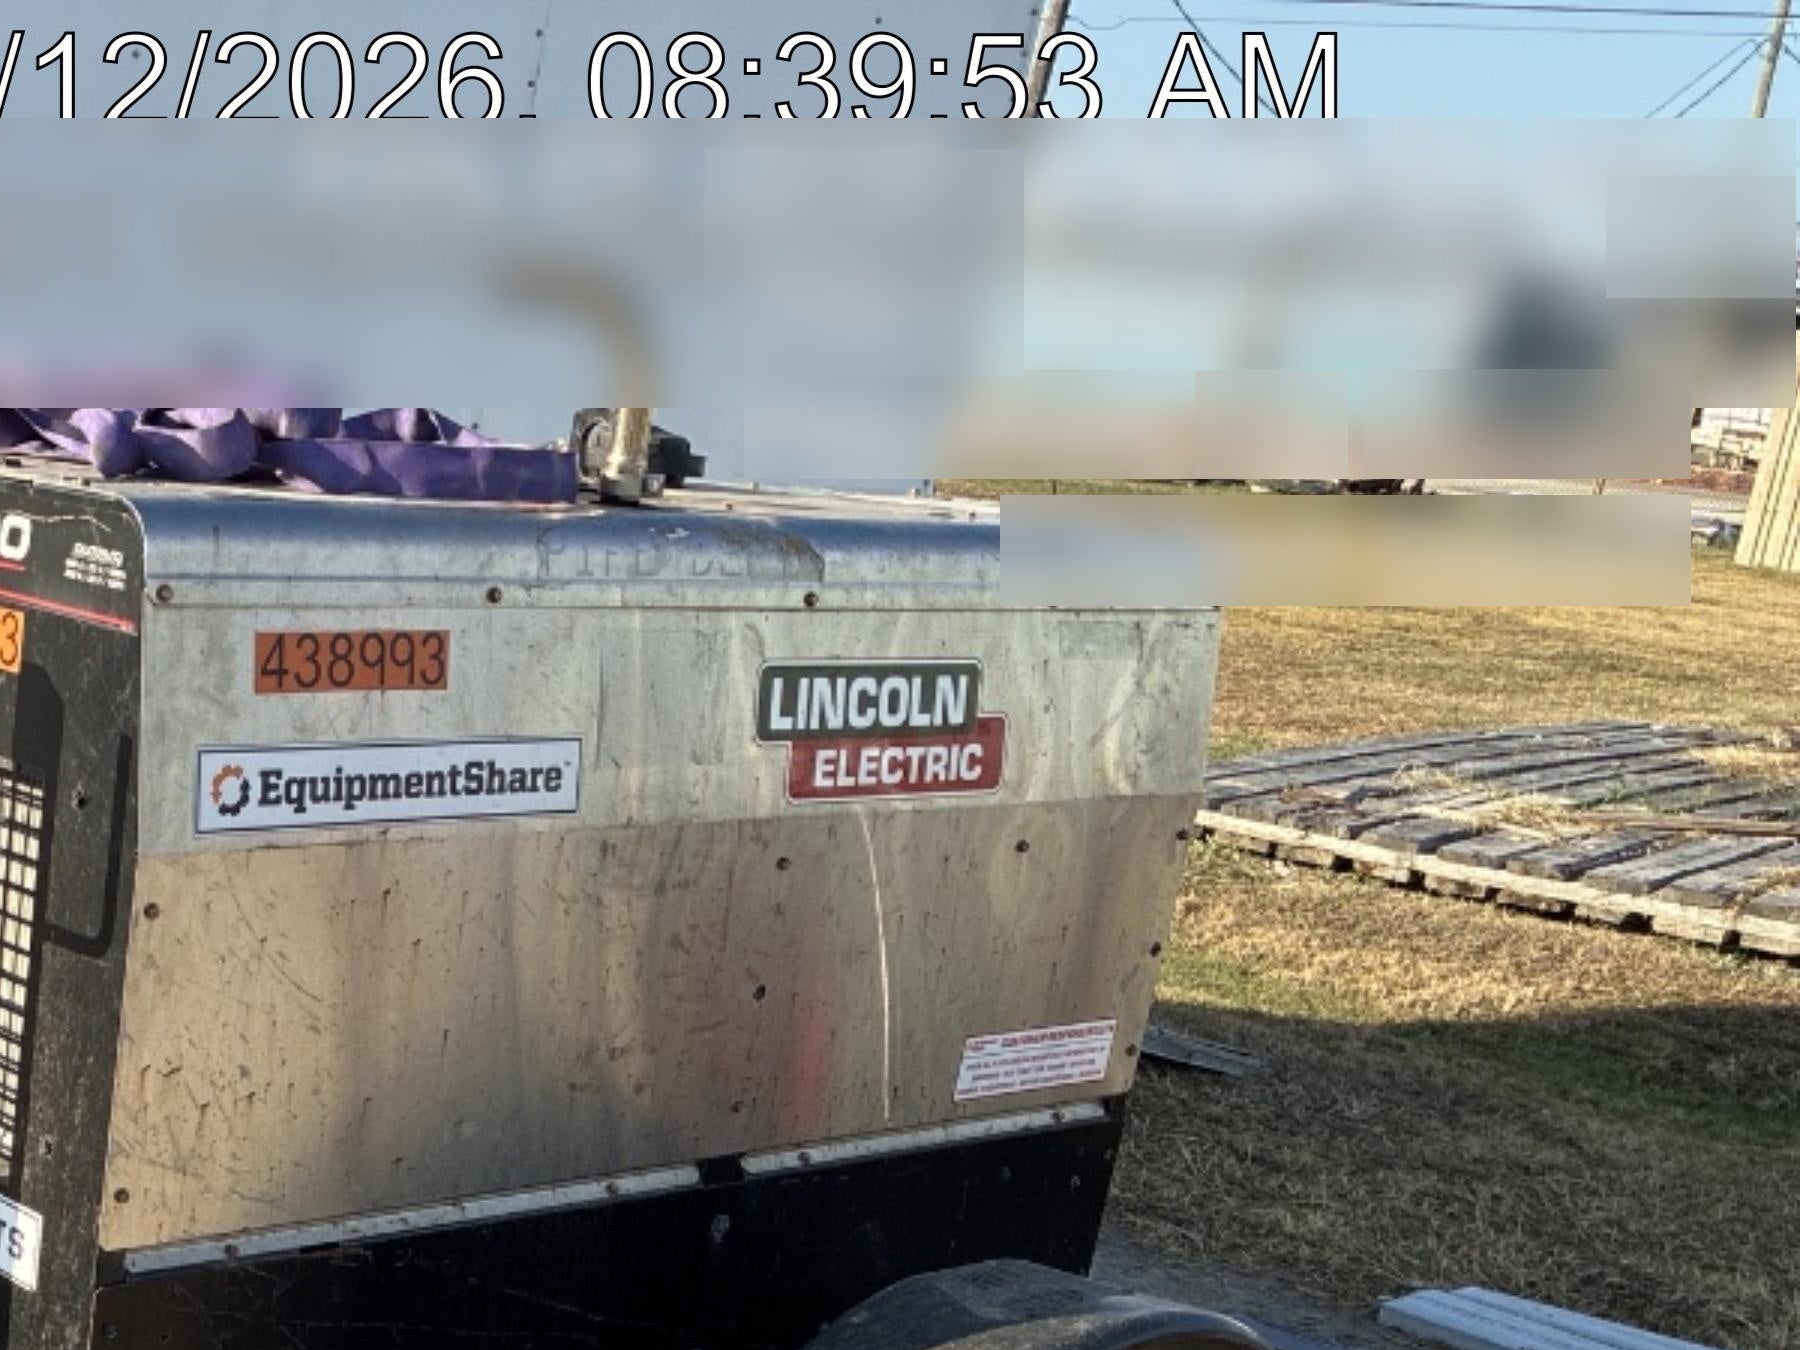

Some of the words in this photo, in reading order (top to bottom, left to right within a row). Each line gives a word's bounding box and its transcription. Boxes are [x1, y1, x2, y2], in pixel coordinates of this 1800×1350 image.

[259, 631, 447, 689] 438993
[769, 673, 970, 731] LINCOLN
[257, 760, 564, 815] EquipmentShare
[812, 742, 985, 788] ELECTRIC
